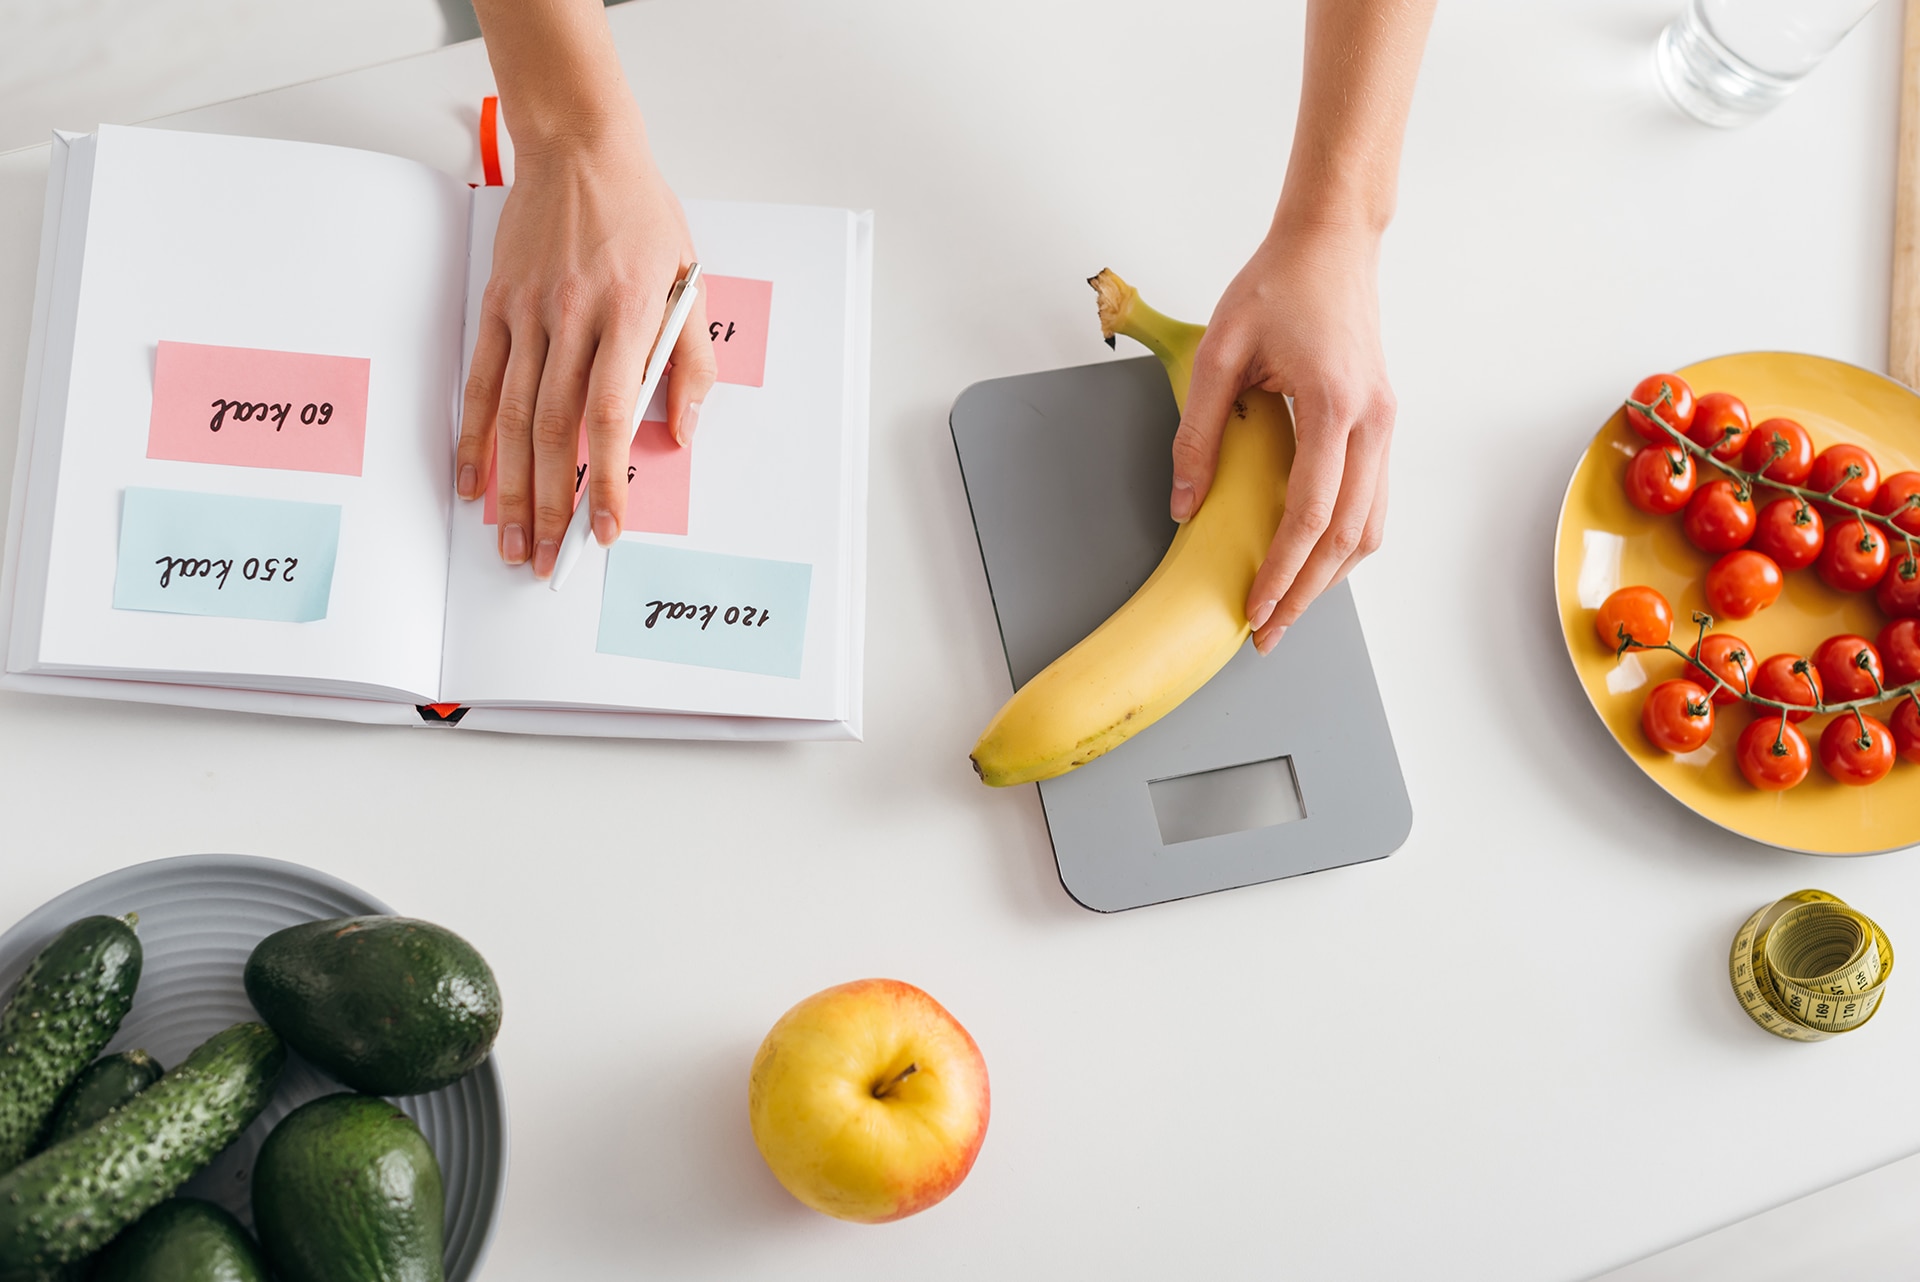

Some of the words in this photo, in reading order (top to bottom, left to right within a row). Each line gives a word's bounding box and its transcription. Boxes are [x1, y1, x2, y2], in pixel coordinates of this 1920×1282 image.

[708, 321, 736, 343] 15
[209, 398, 292, 433] kcal
[300, 402, 334, 426] 60
[155, 556, 234, 590] kcal
[242, 557, 298, 582] 250
[644, 600, 718, 631] kcal
[723, 605, 770, 627] 120
[1855, 970, 1868, 990] 158
[1789, 994, 1802, 1013] 168
[1816, 1003, 1830, 1019] 169
[1843, 1003, 1857, 1019] 170
